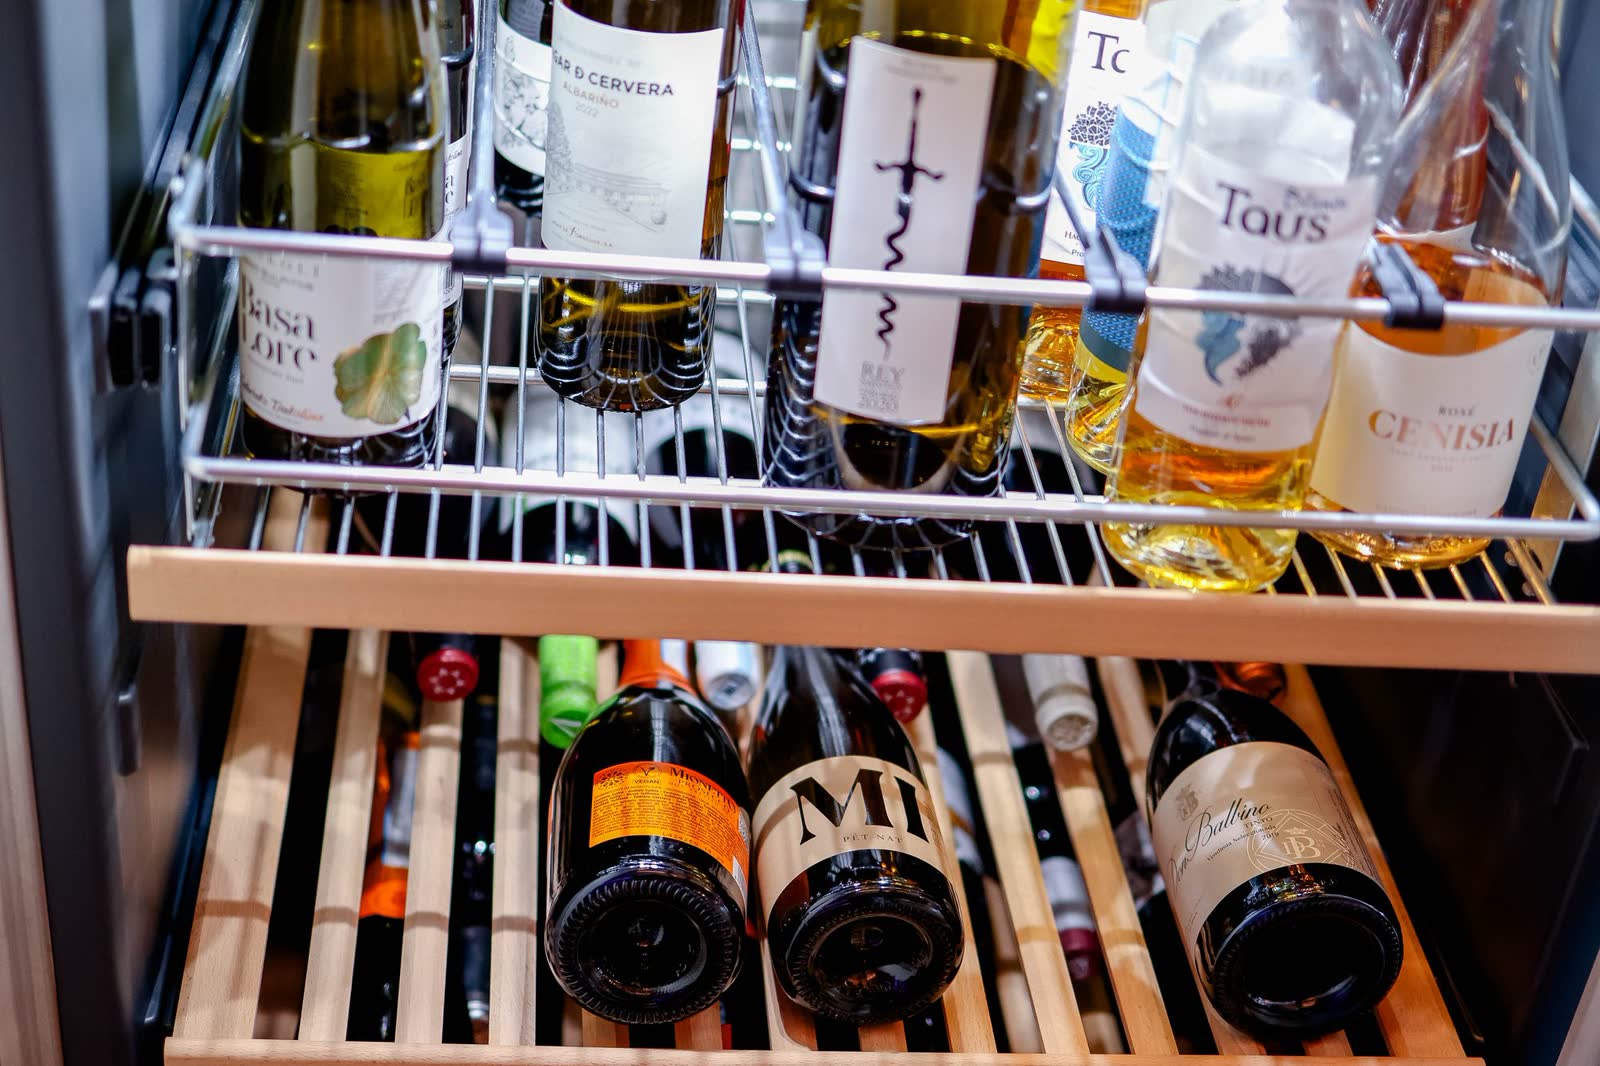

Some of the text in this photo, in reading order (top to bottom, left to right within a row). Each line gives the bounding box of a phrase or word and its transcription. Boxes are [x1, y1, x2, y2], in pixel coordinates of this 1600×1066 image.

[588, 72, 674, 97] CERVERA
[1215, 182, 1332, 243] Taus
[1185, 797, 1272, 862] Balbino
[1244, 816, 1273, 829] TINTO
